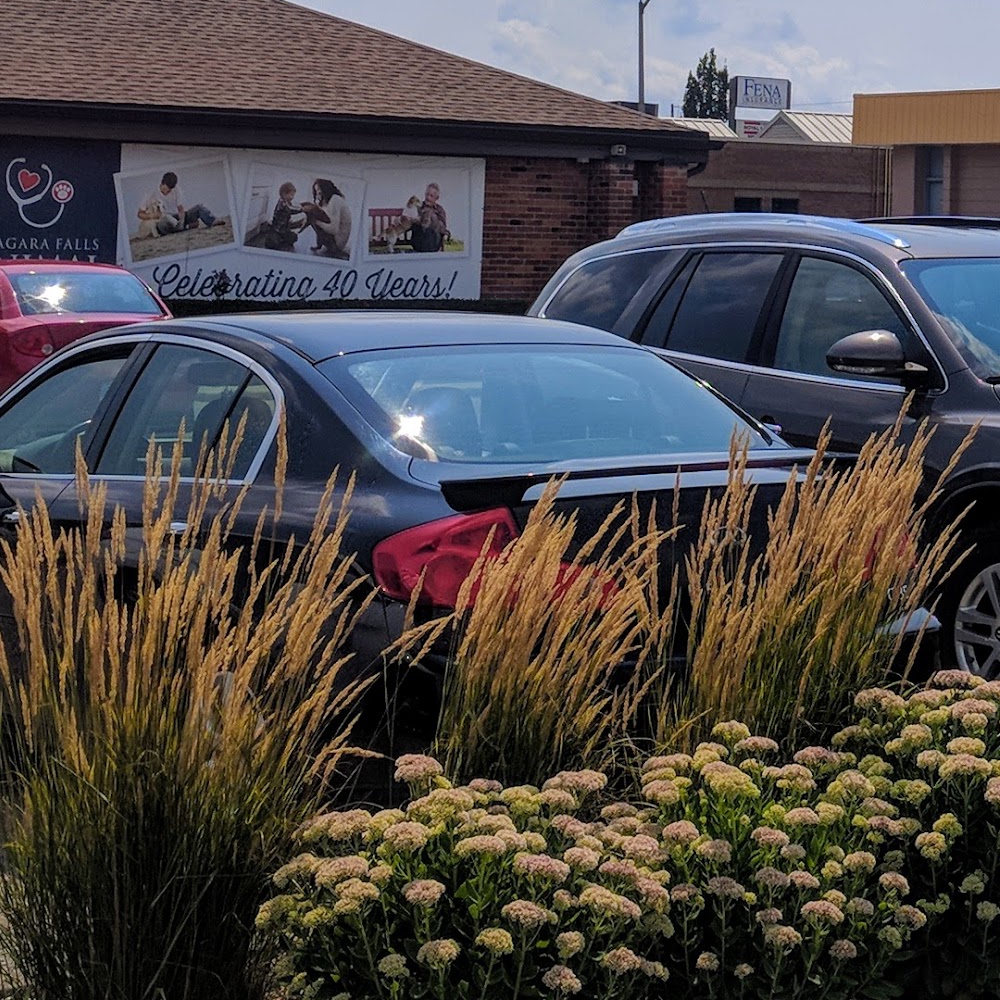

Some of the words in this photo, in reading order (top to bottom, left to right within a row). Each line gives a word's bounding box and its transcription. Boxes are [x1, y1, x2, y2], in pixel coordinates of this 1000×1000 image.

[744, 79, 781, 98] FENA
[56, 237, 100, 250] FALLS
[153, 263, 317, 300] Celerating
[323, 269, 358, 298] 40
[365, 267, 459, 300] Years!
